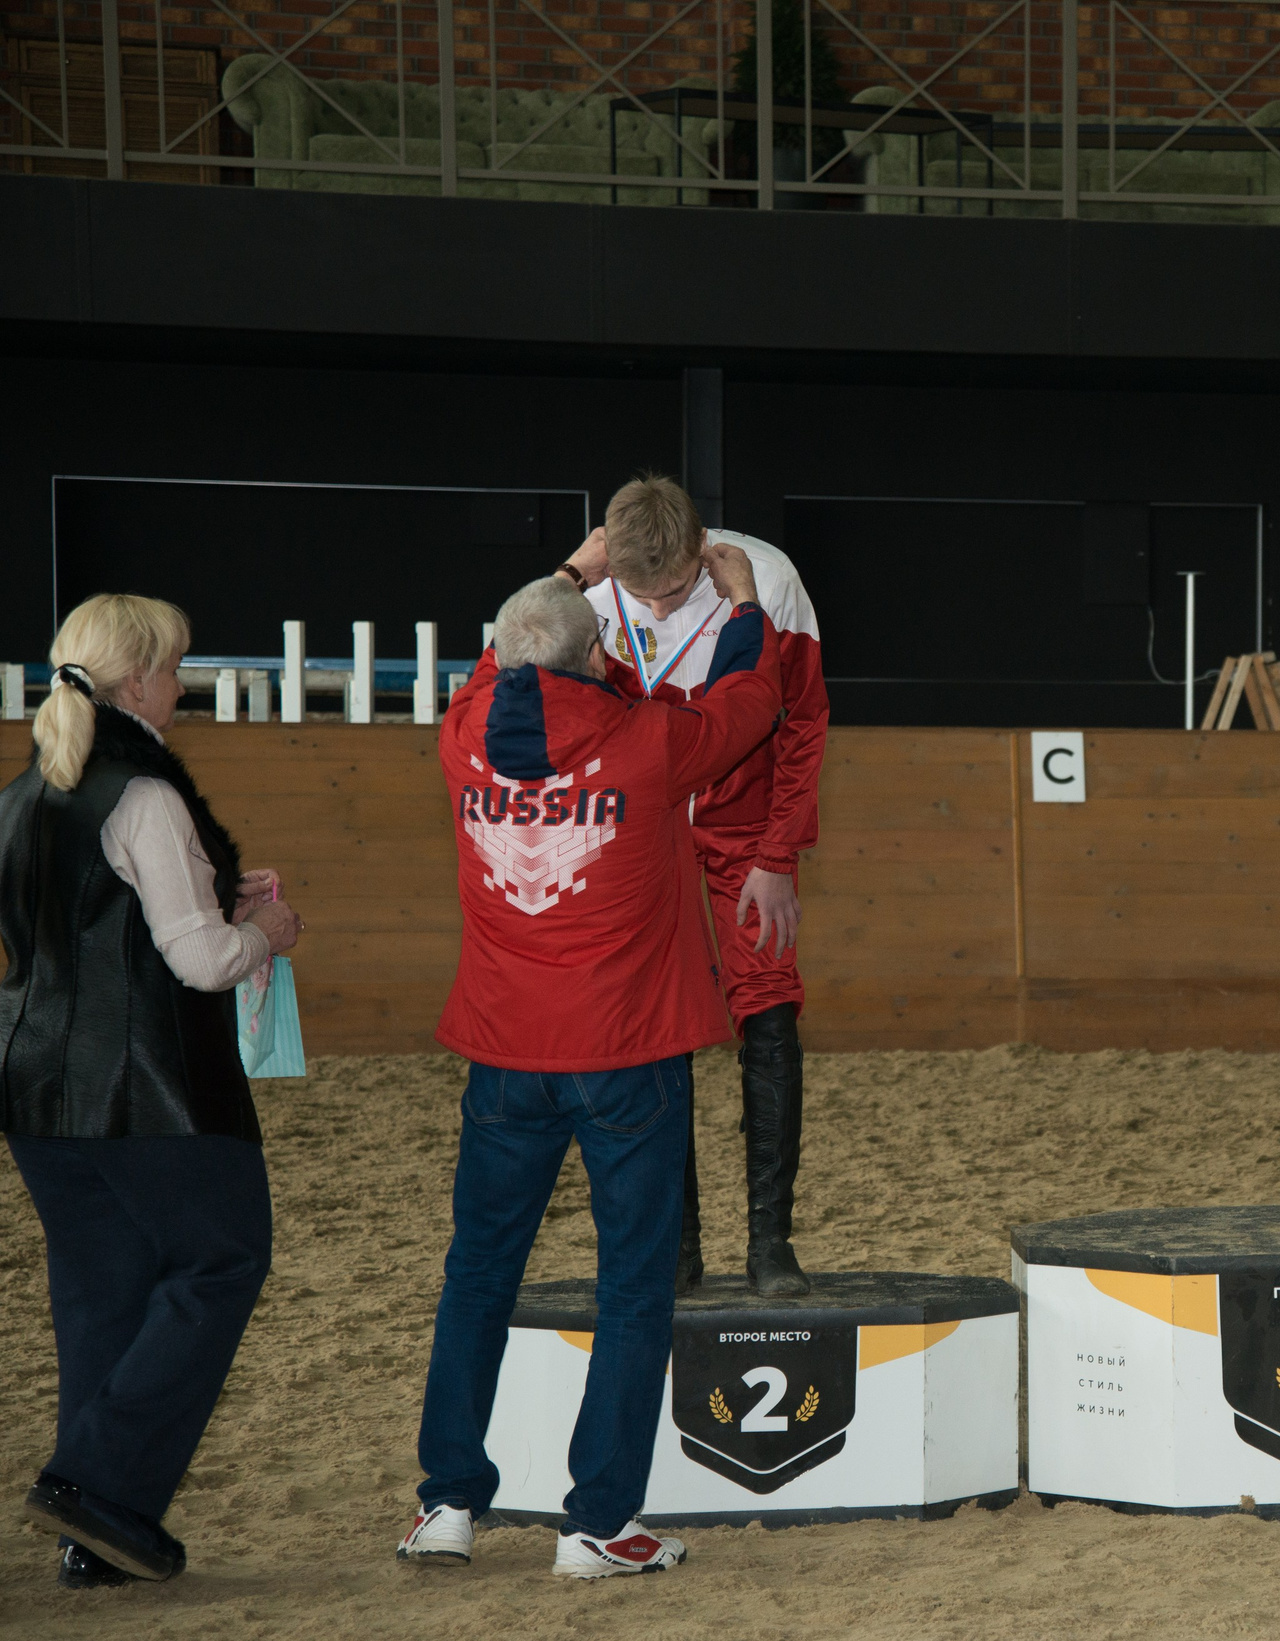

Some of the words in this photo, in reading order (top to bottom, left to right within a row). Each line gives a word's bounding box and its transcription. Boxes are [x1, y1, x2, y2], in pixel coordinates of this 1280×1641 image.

[1042, 747, 1076, 785] C
[459, 784, 627, 826] RUSSIA
[719, 1332, 767, 1343] ВТОРОЕ
[769, 1331, 811, 1342] МЕСТО
[1076, 1353, 1126, 1367] НОВЫЙ
[1078, 1378, 1123, 1392] СТИЛЬ
[740, 1366, 789, 1433] 2
[1076, 1403, 1125, 1417] ЖИЗНИ
